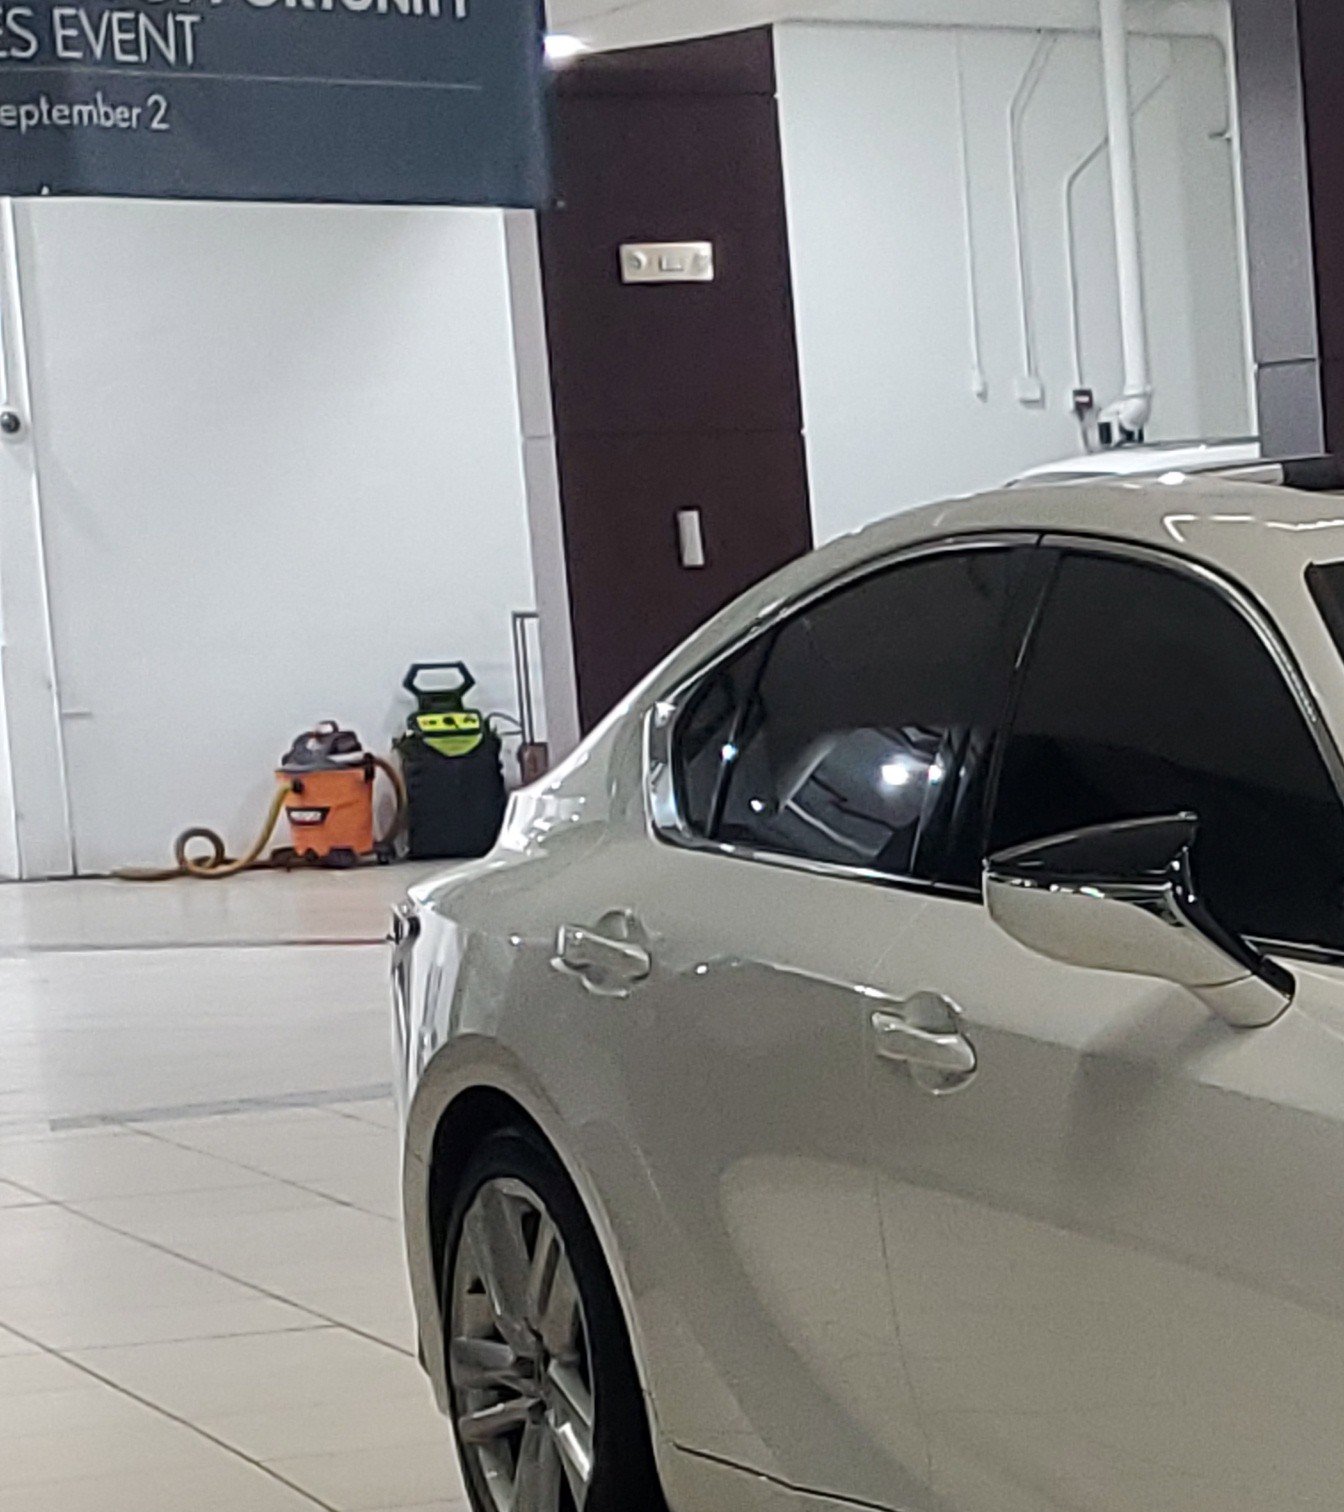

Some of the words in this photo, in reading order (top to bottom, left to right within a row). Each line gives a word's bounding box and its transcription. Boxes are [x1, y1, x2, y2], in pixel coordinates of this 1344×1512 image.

[0, 7, 38, 60] S
[52, 7, 201, 67] EVENT
[0, 91, 142, 135] eptember
[147, 94, 170, 130] 2
